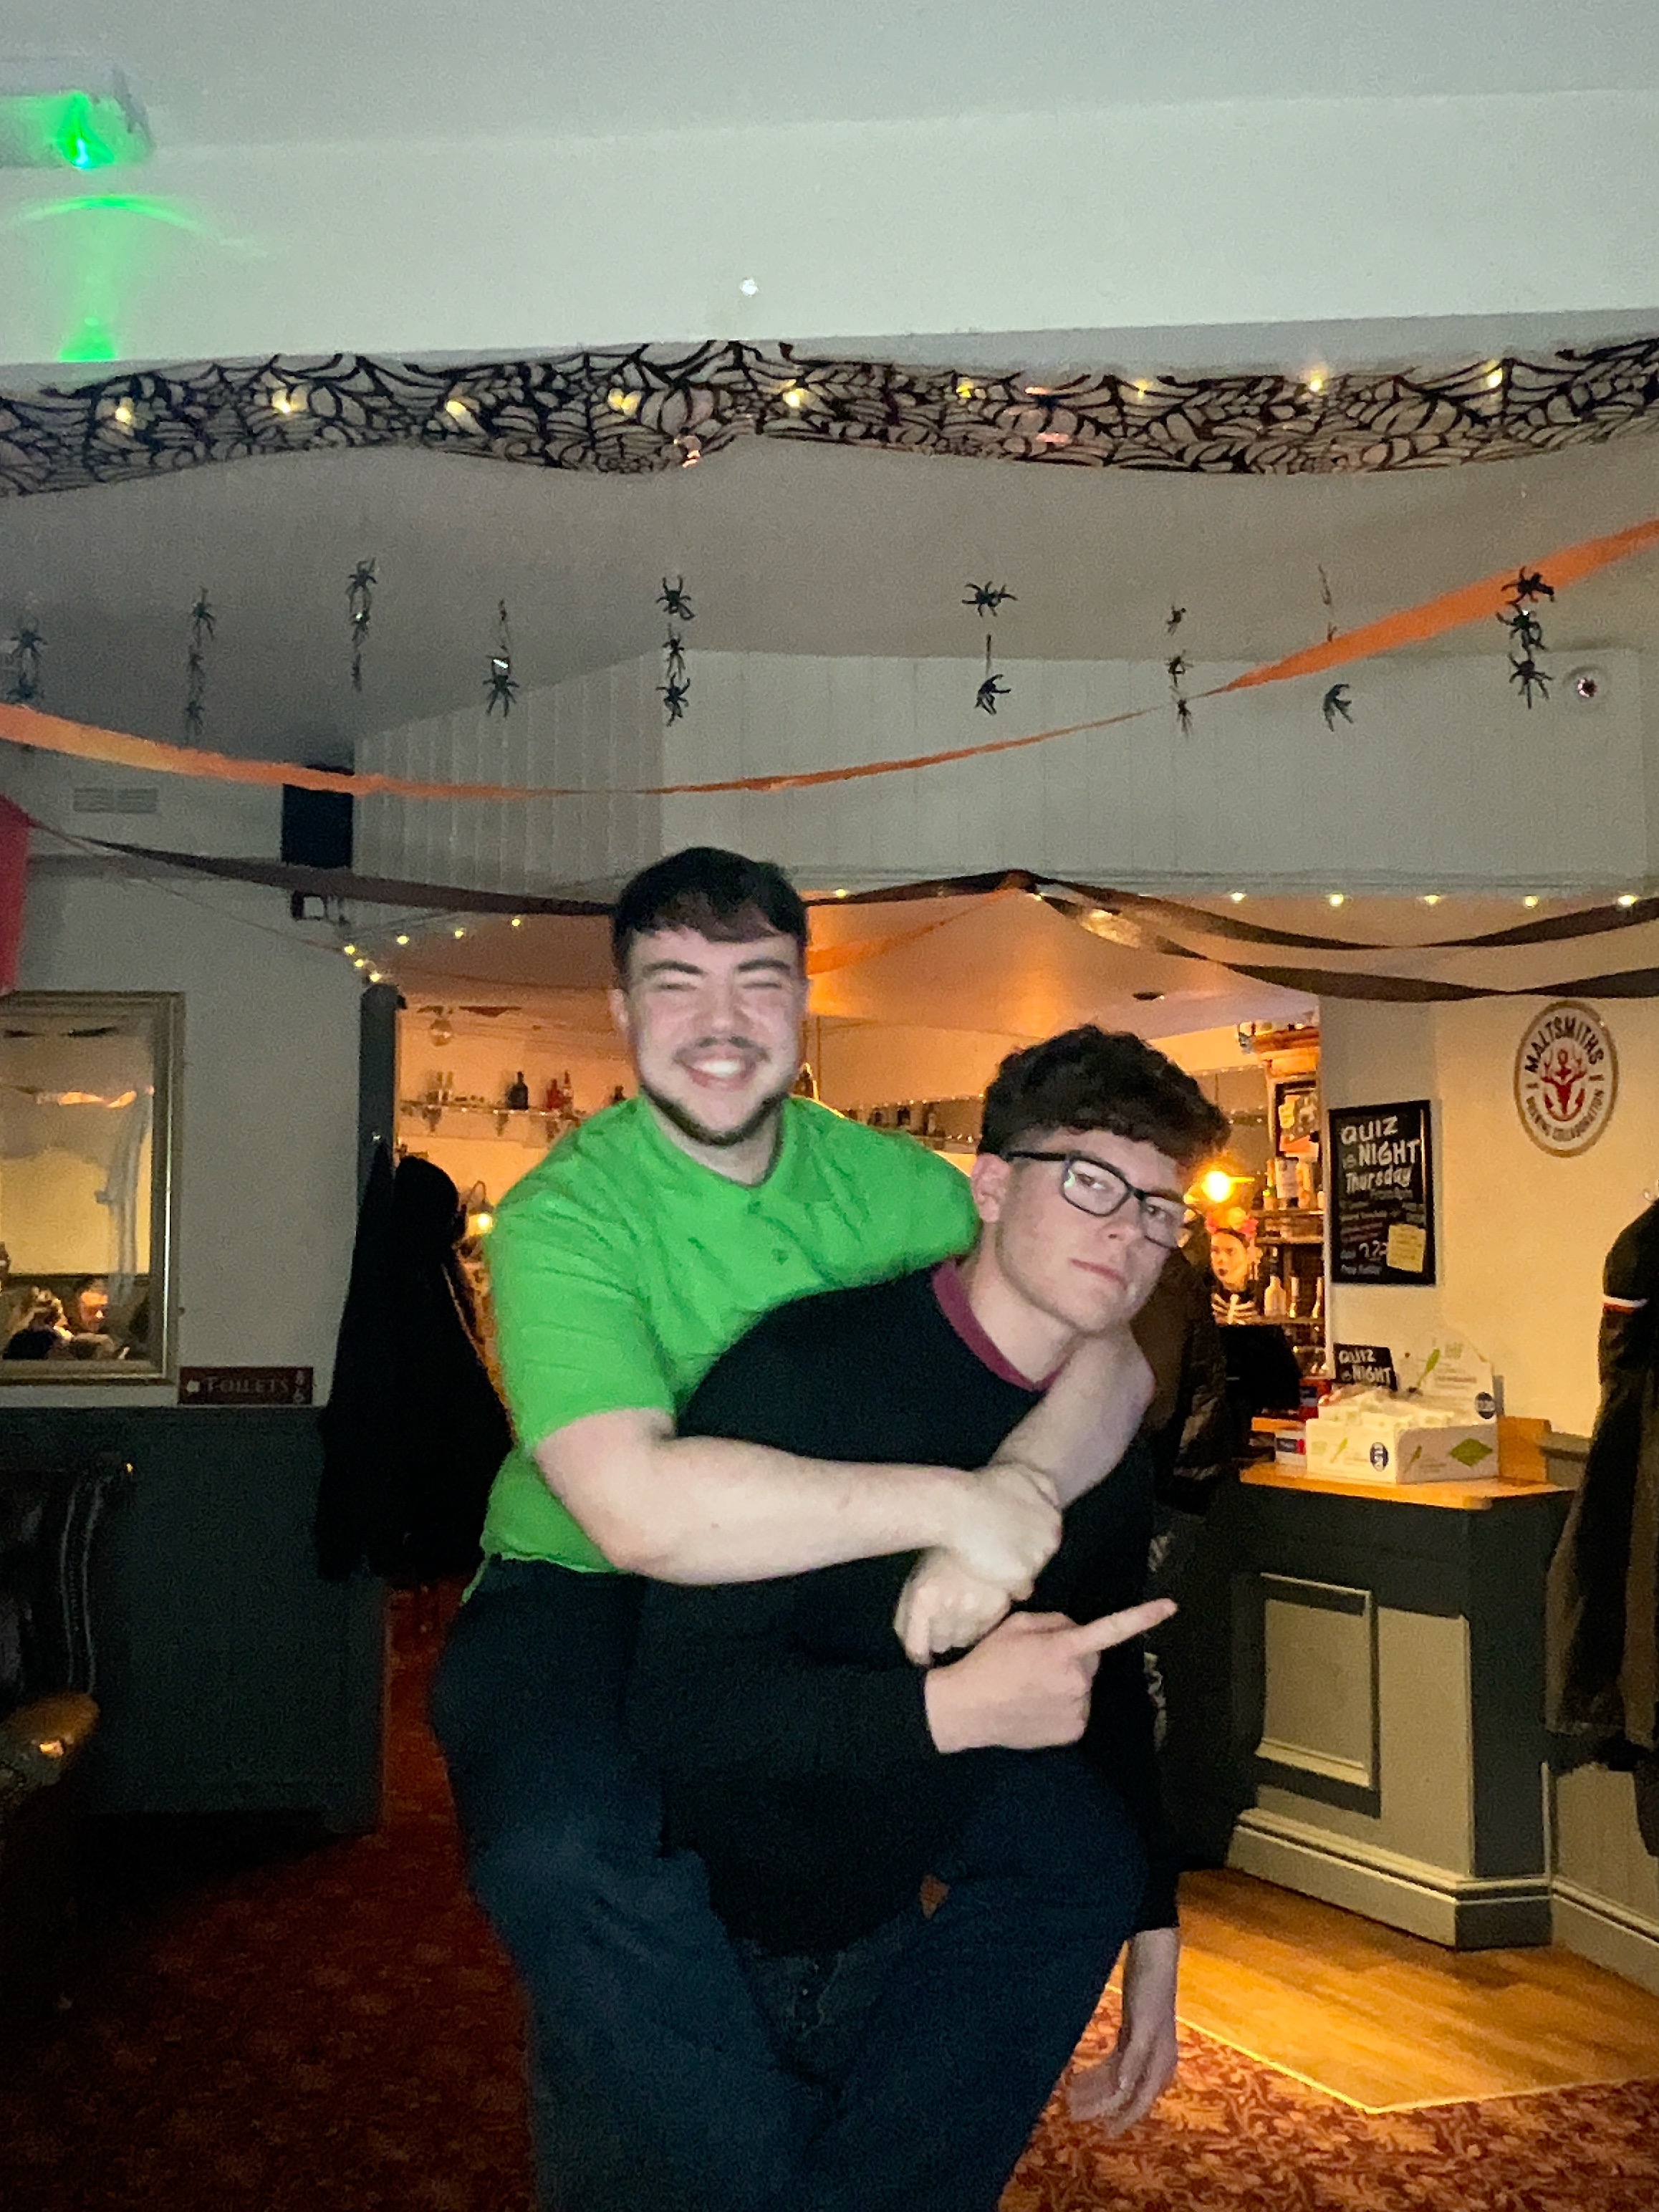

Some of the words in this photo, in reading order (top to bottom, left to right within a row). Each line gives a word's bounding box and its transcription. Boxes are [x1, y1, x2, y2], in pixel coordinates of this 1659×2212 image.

[1524, 1016, 1605, 1073] MALTSMITHS
[1341, 1115, 1398, 1145] QUIZ
[1358, 1140, 1420, 1166] NIGHT
[1346, 1165, 1412, 1195] Thursday
[1338, 1348, 1376, 1364] QUIZ
[203, 1375, 289, 1394] TOILETS
[1352, 1364, 1390, 1385] NIGHT
